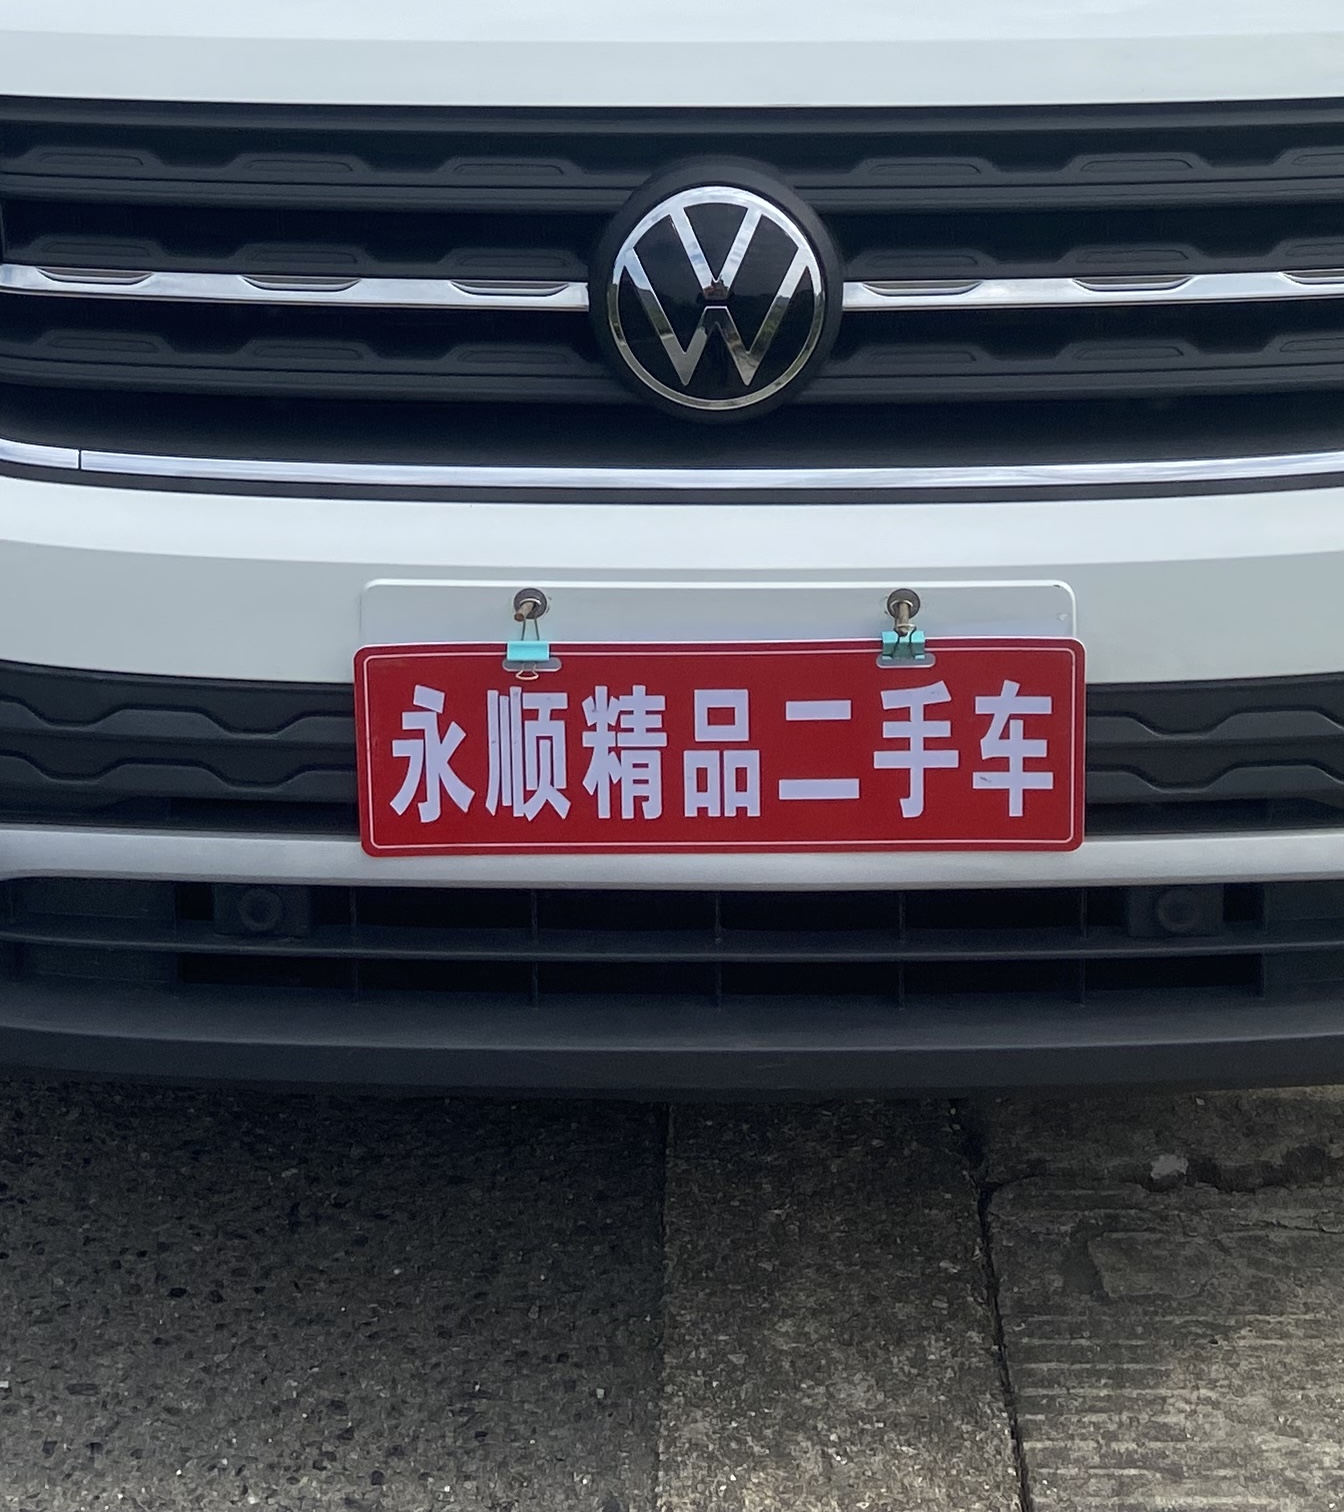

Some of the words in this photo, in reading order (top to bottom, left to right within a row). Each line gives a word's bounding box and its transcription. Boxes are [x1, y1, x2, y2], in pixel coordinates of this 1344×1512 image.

[390, 681, 1054, 822] 永顺精品二手车
